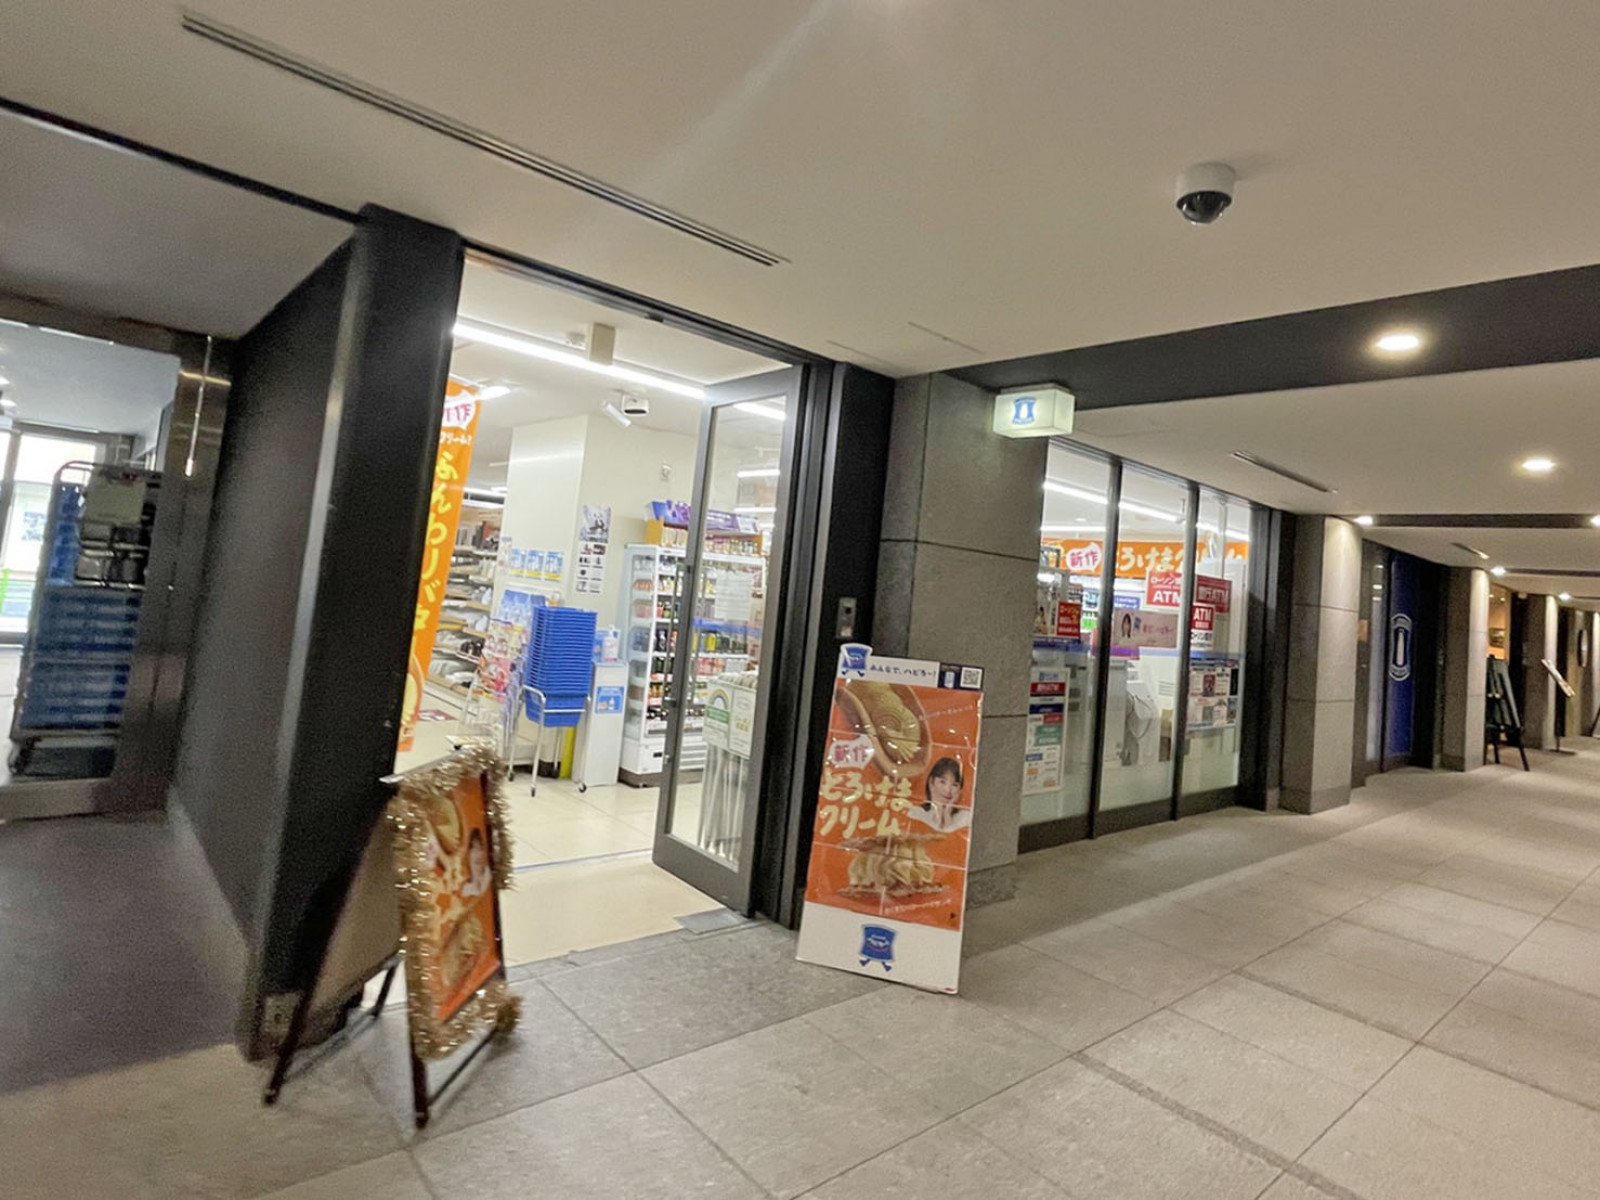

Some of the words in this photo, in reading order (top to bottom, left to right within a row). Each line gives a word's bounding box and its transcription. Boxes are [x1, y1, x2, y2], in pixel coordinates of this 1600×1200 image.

[1069, 550, 1098, 568] 新作
[819, 804, 901, 839] クリーム
